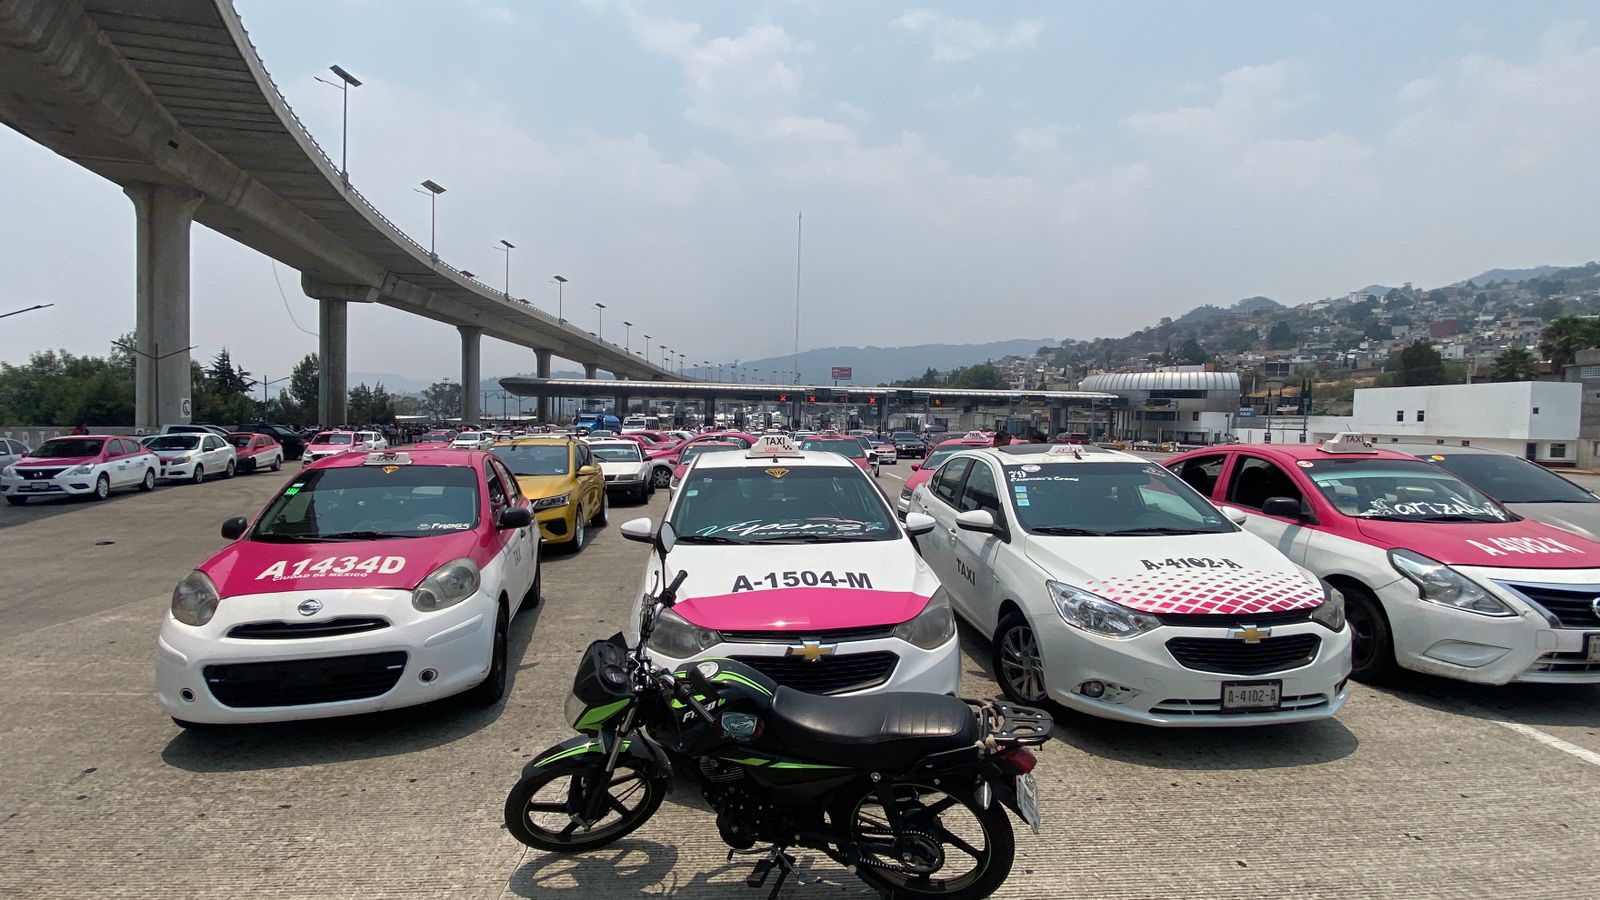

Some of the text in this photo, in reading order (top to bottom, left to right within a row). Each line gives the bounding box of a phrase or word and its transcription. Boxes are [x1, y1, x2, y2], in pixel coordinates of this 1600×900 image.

[765, 437, 785, 446] TAXI
[1345, 435, 1364, 443] TAXI
[255, 556, 407, 580] A1434D
[1140, 558, 1244, 570] A-4102-A
[272, 573, 310, 581] CIUDAD
[956, 558, 976, 587] TAXI
[731, 571, 873, 593] A-1504-M
[1228, 688, 1276, 704] A-4102-A
